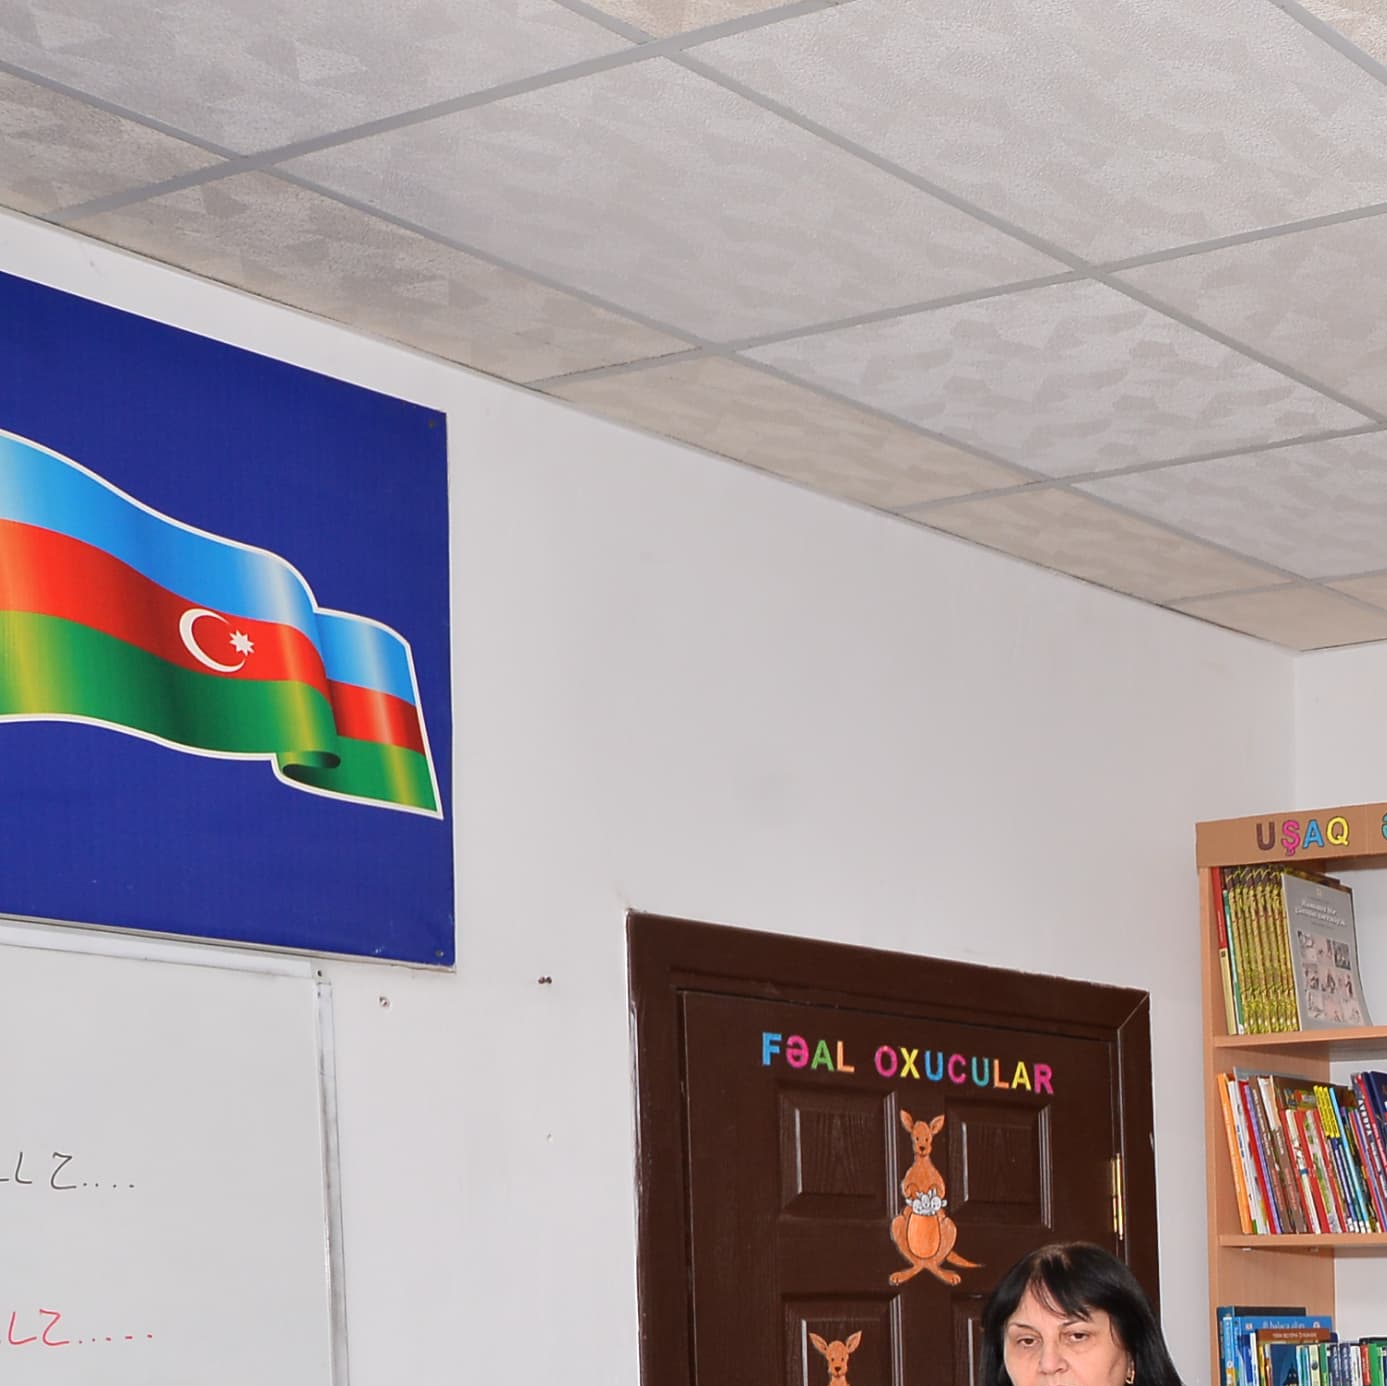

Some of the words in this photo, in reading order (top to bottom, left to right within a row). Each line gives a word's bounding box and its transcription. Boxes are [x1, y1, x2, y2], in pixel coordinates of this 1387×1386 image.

[1255, 816, 1351, 857] UŞAQ
[761, 1031, 855, 1073] FƏAL
[874, 1045, 1055, 1095] OXUCULAR
